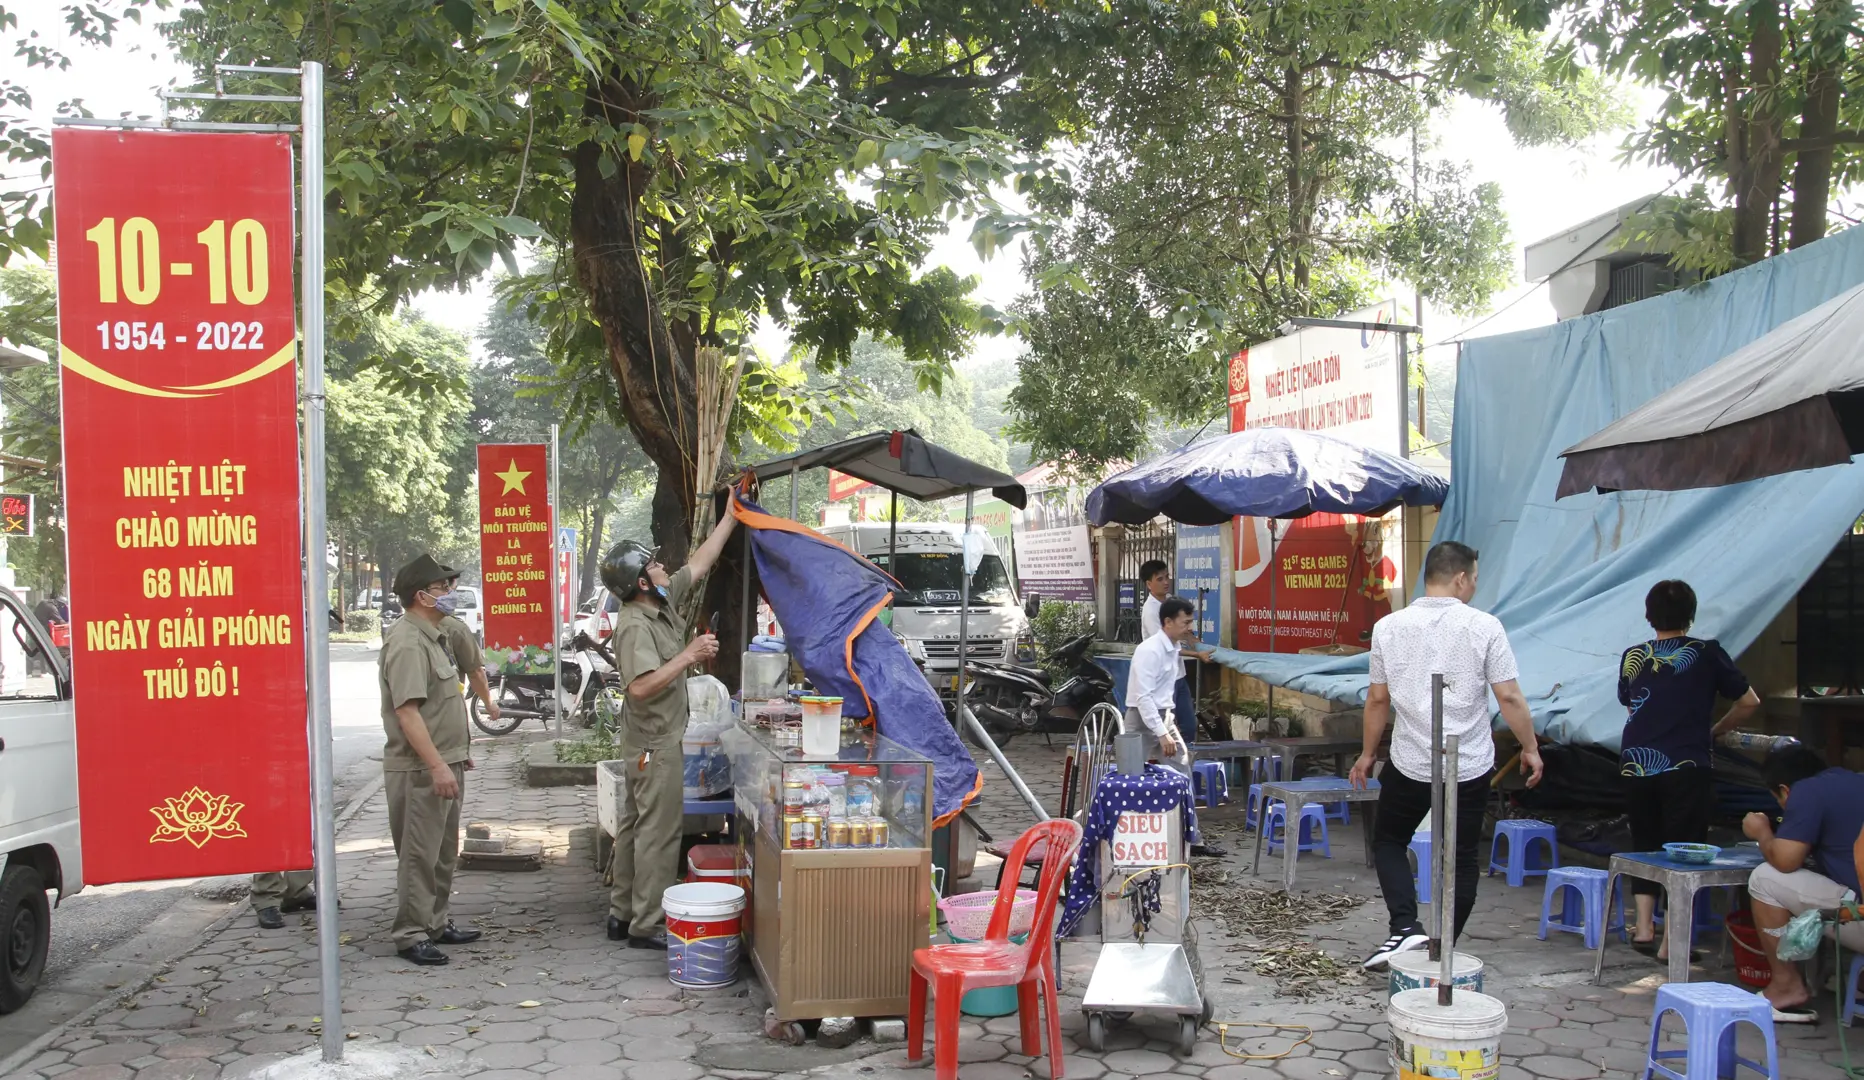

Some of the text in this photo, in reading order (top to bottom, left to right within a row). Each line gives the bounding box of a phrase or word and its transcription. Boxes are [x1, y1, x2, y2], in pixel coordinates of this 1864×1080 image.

[97, 321, 166, 350] 1954
[196, 321, 264, 350] 2022
[1265, 351, 1340, 402] NHIỆT LIỆT CHÀO ĐÓN
[1337, 400, 1344, 426] 31
[1345, 392, 1359, 424] NĂM
[1359, 392, 1373, 420] 2021
[123, 459, 246, 504] NHIỆT LIỆT
[494, 503, 532, 518] BẢO VỆ
[116, 510, 257, 548] CHÀO MỪNG
[483, 520, 548, 534] MÔI TRƯỜNG
[507, 537, 521, 549] LÀ
[496, 552, 533, 567] BẢO VỆ
[1300, 557, 1316, 570] SEA
[1318, 556, 1347, 569] GAMES
[143, 560, 234, 599] 68 NĂM
[485, 568, 545, 584] CUỘC SỐNG
[1284, 574, 1347, 588] VIETNAM 2021
[505, 584, 527, 598] CỦA
[491, 601, 543, 615] CHÚNG TA
[1238, 607, 1245, 620] VÌ
[1245, 606, 1258, 622] MỘT
[1276, 609, 1291, 621] NAM
[1292, 607, 1298, 620] Á
[1298, 610, 1320, 624] MẠNH
[1320, 608, 1331, 622] MẼ
[86, 607, 291, 651] NGÀY GIẢI PHÓNG
[1249, 626, 1259, 635] FOR
[1290, 627, 1323, 638] SOUTHEAST
[143, 658, 189, 700] THỦ
